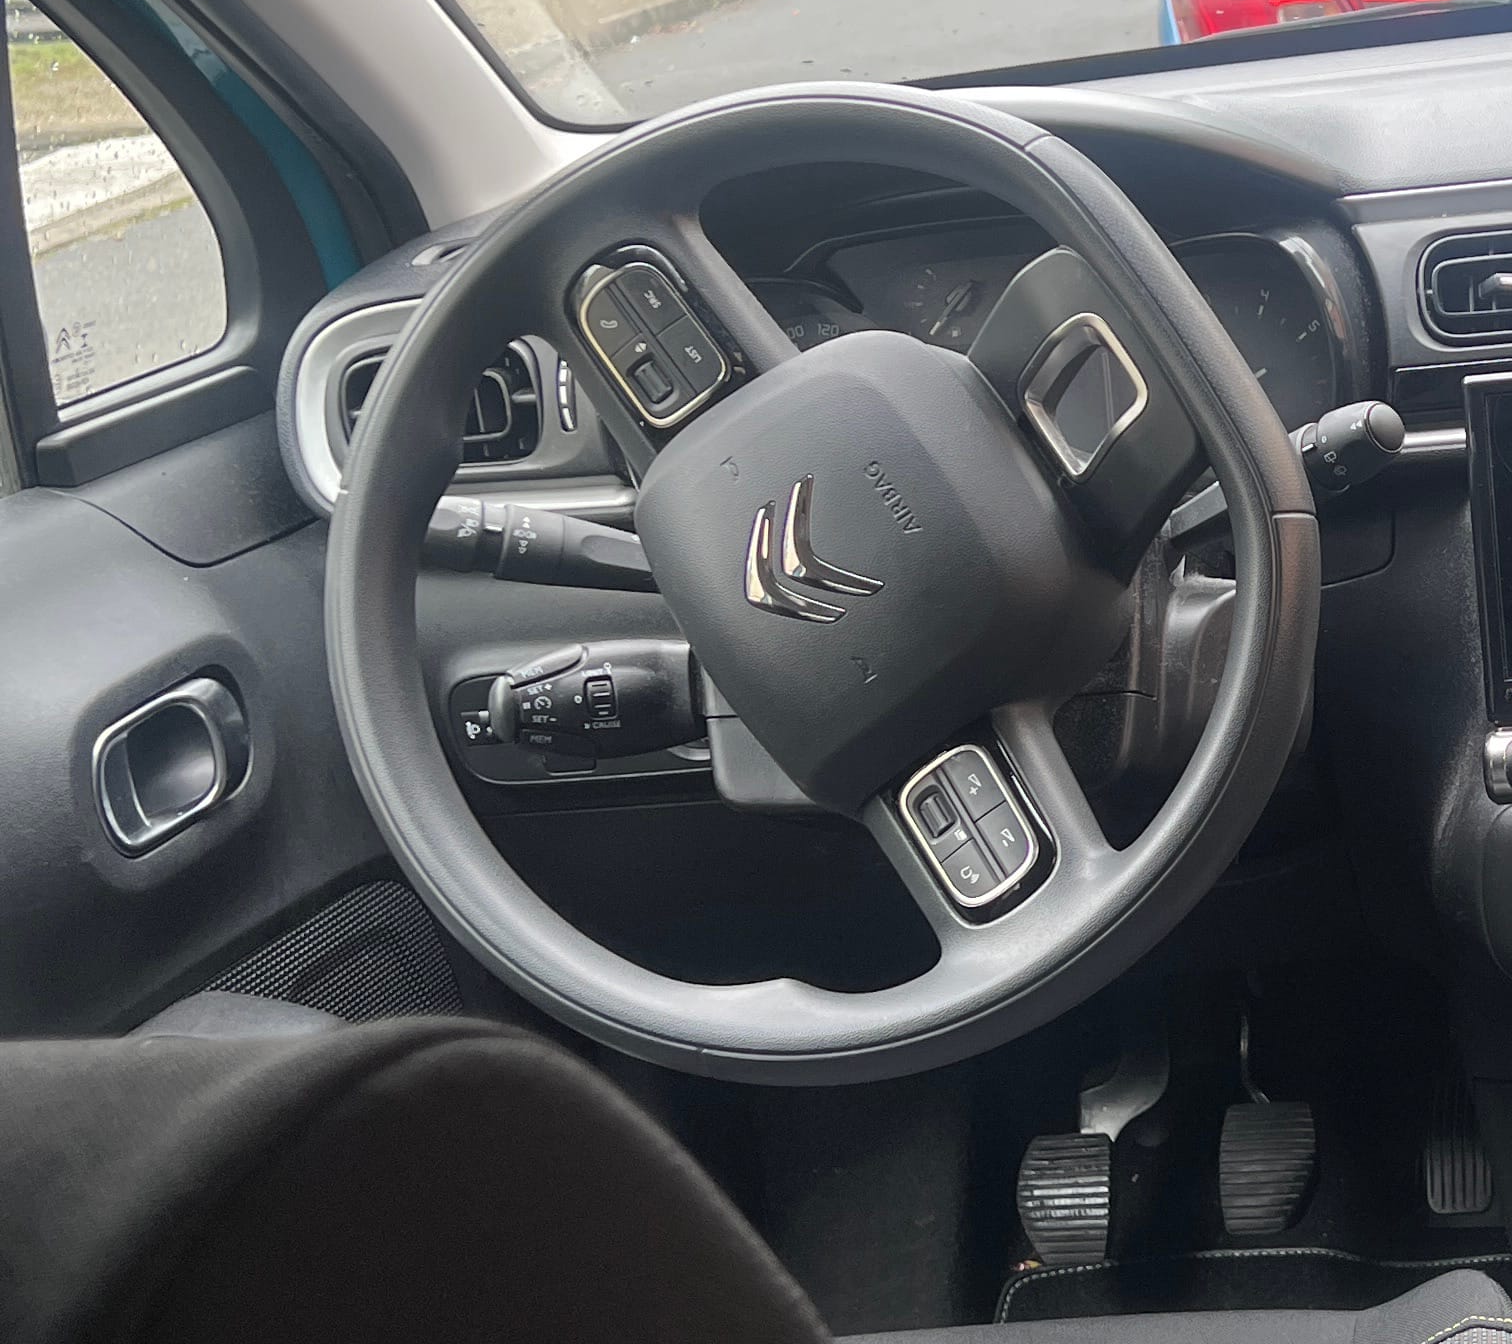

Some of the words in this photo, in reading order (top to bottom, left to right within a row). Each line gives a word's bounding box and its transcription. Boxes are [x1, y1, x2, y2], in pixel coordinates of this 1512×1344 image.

[786, 324, 805, 340] 00
[816, 323, 840, 337] 120
[1308, 319, 1320, 332] 5
[684, 345, 702, 363] LIST
[864, 460, 923, 534] AIRBAG
